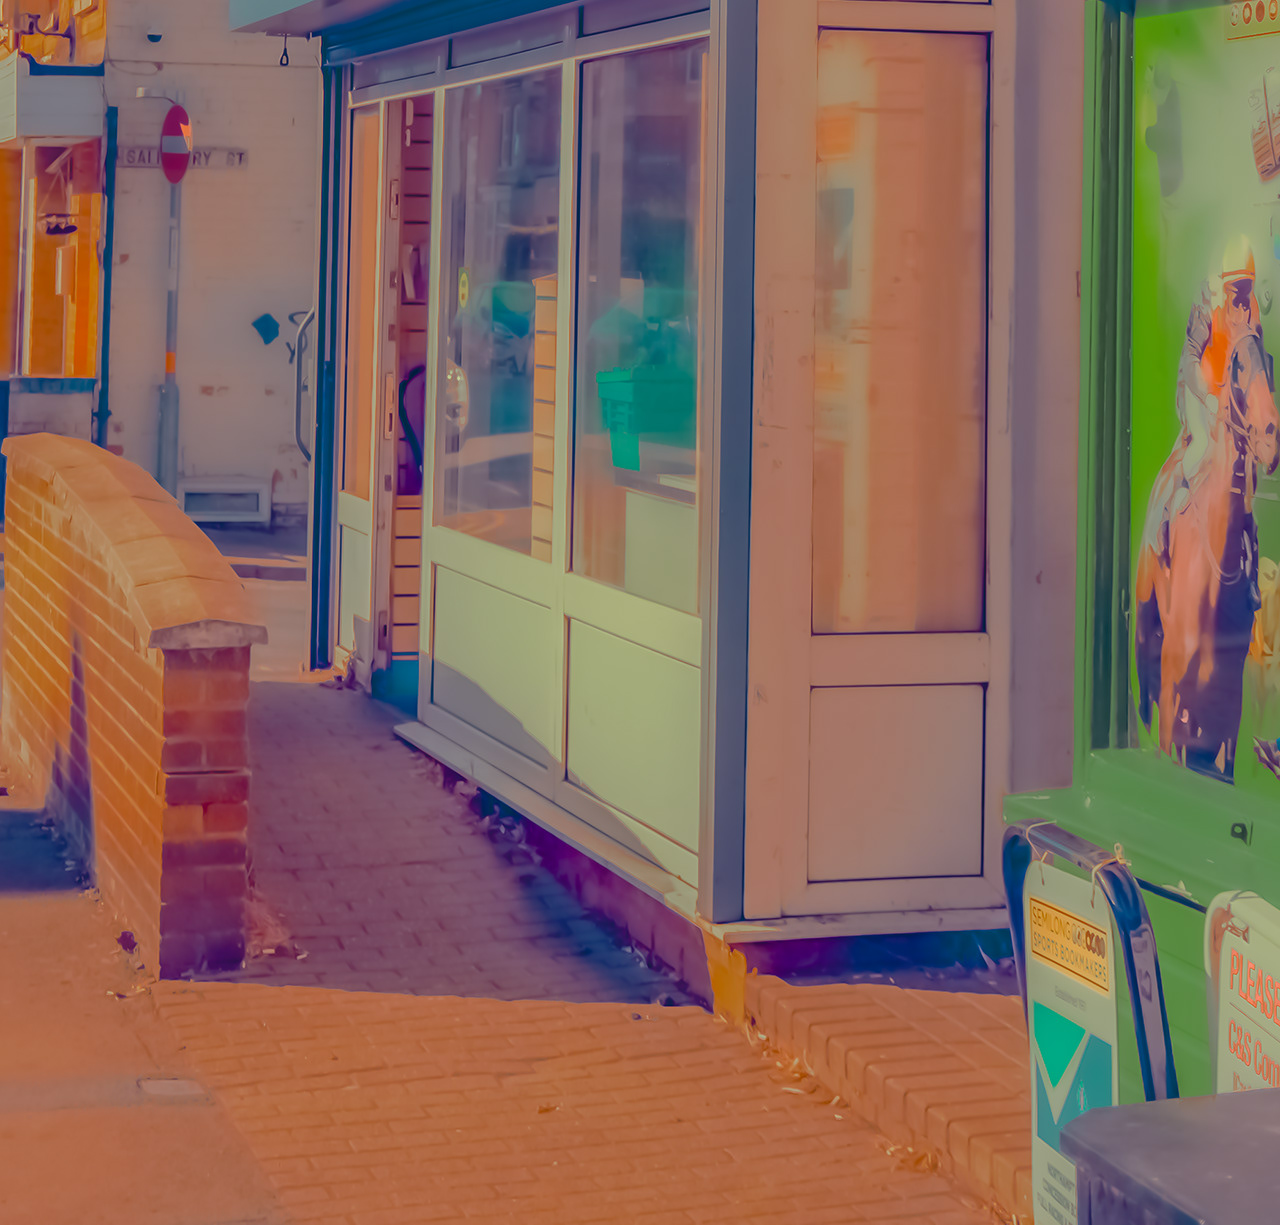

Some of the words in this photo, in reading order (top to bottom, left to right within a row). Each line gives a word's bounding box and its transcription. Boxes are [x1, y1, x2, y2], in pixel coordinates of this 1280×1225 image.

[1033, 906, 1070, 941] SEMILONG
[1034, 932, 1058, 957] SPORTS
[1061, 944, 1106, 983] BOOKMAKERS
[1229, 1019, 1251, 1067] C&S
